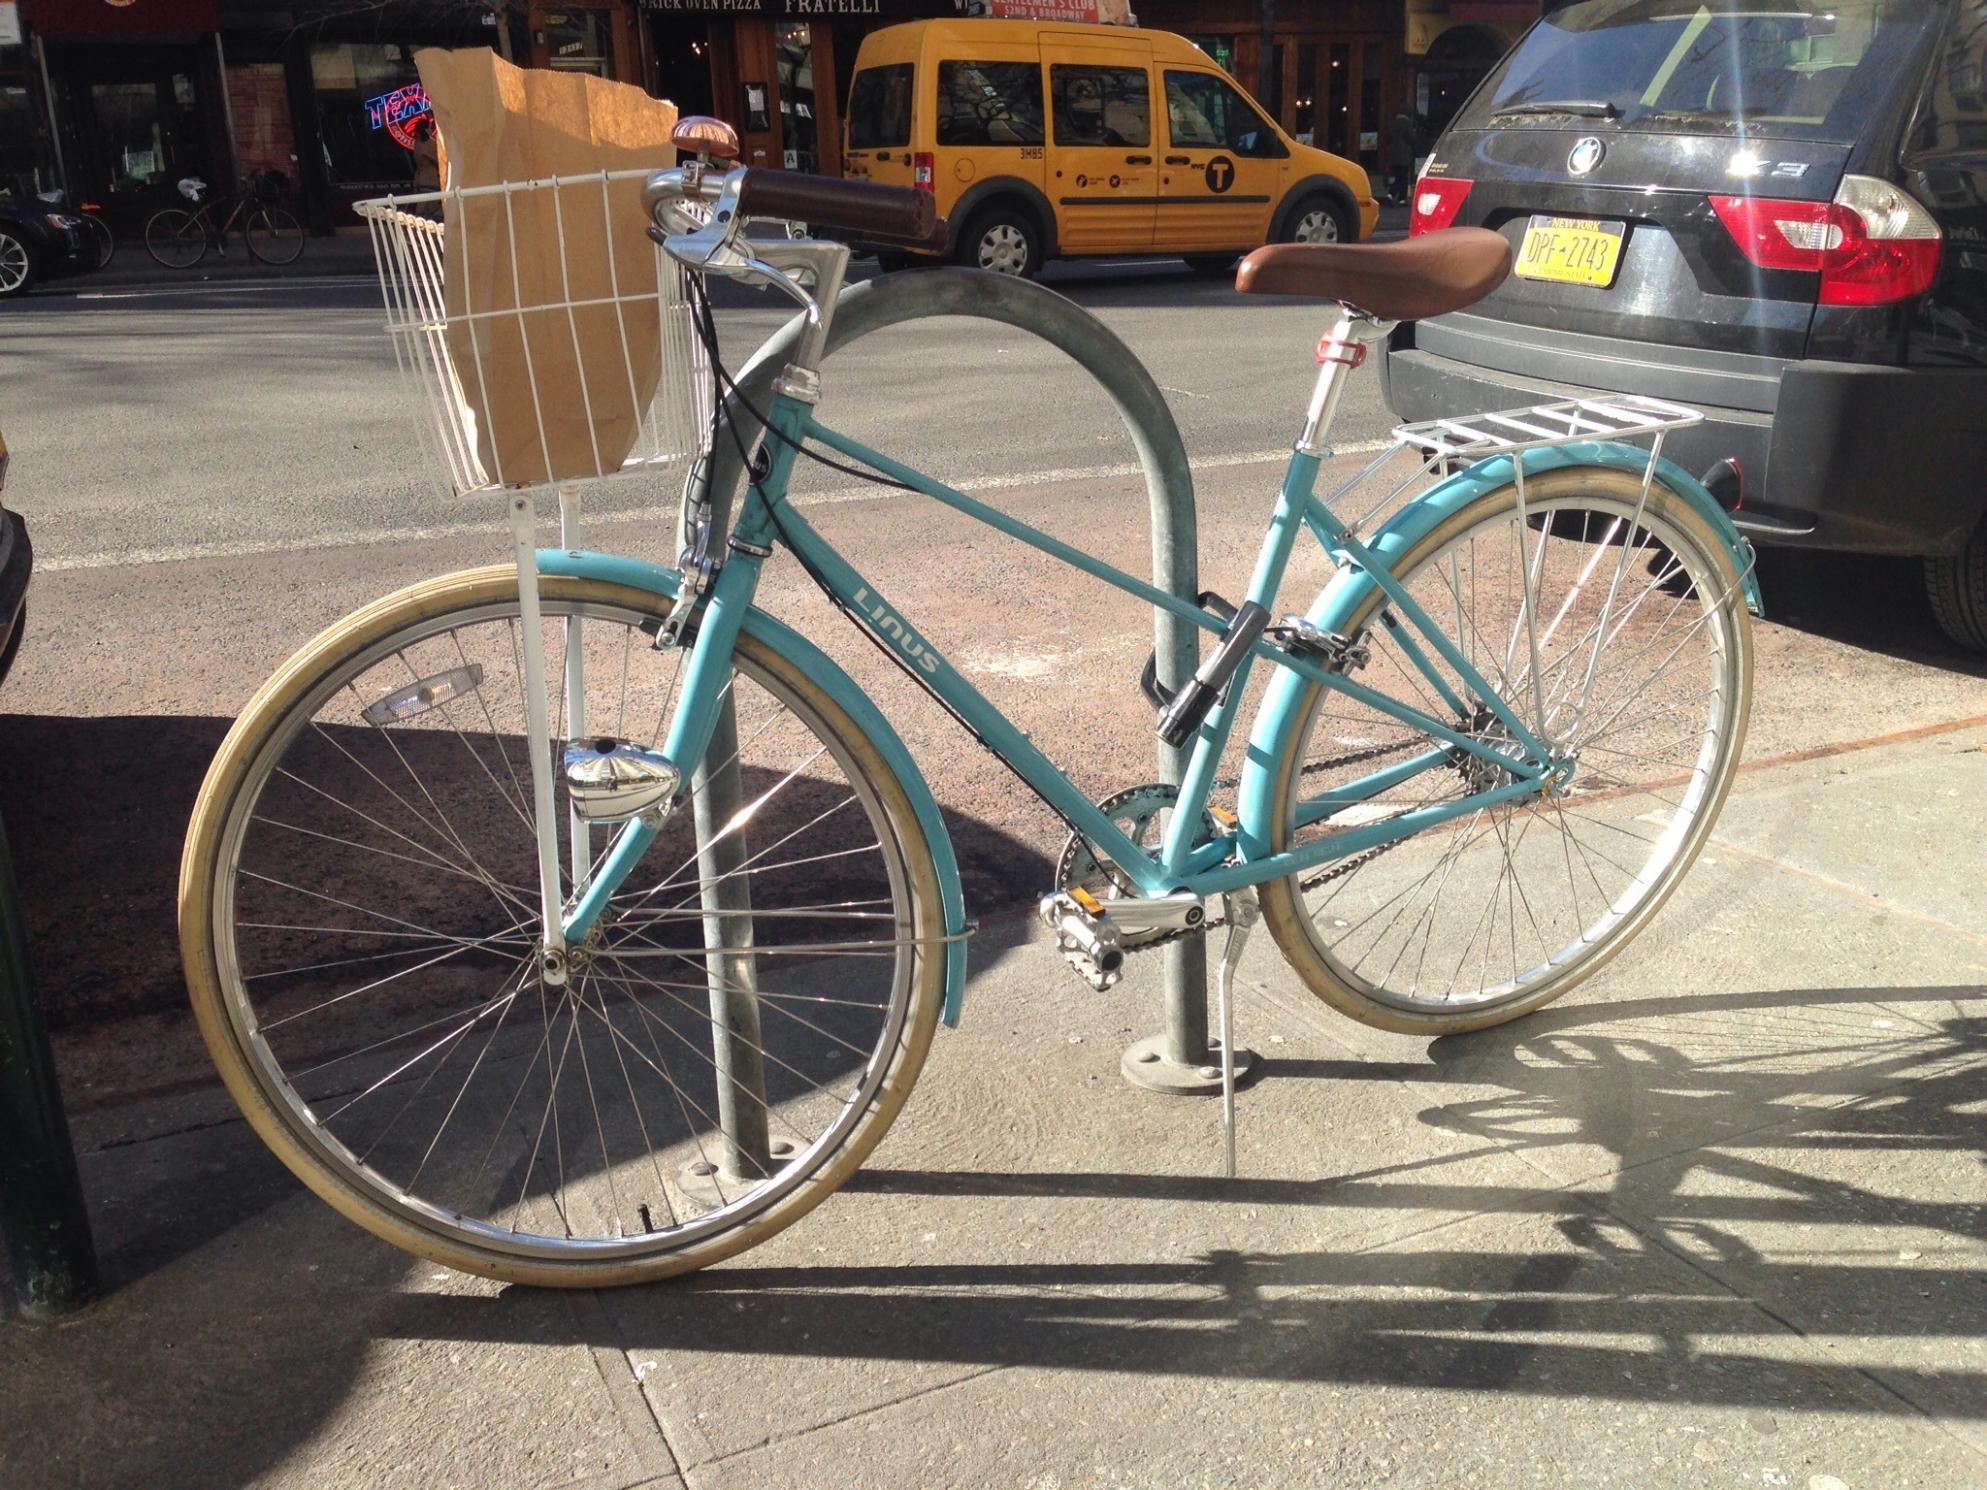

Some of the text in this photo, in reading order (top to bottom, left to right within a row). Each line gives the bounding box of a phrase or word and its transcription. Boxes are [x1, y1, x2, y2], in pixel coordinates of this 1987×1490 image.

[723, 0, 761, 10] PIZZA
[785, 0, 880, 13] FRATELLI
[1068, 0, 1096, 10] CLUB
[1040, 7, 1086, 19] BROADWAY
[1551, 218, 1600, 231] NEW YORK
